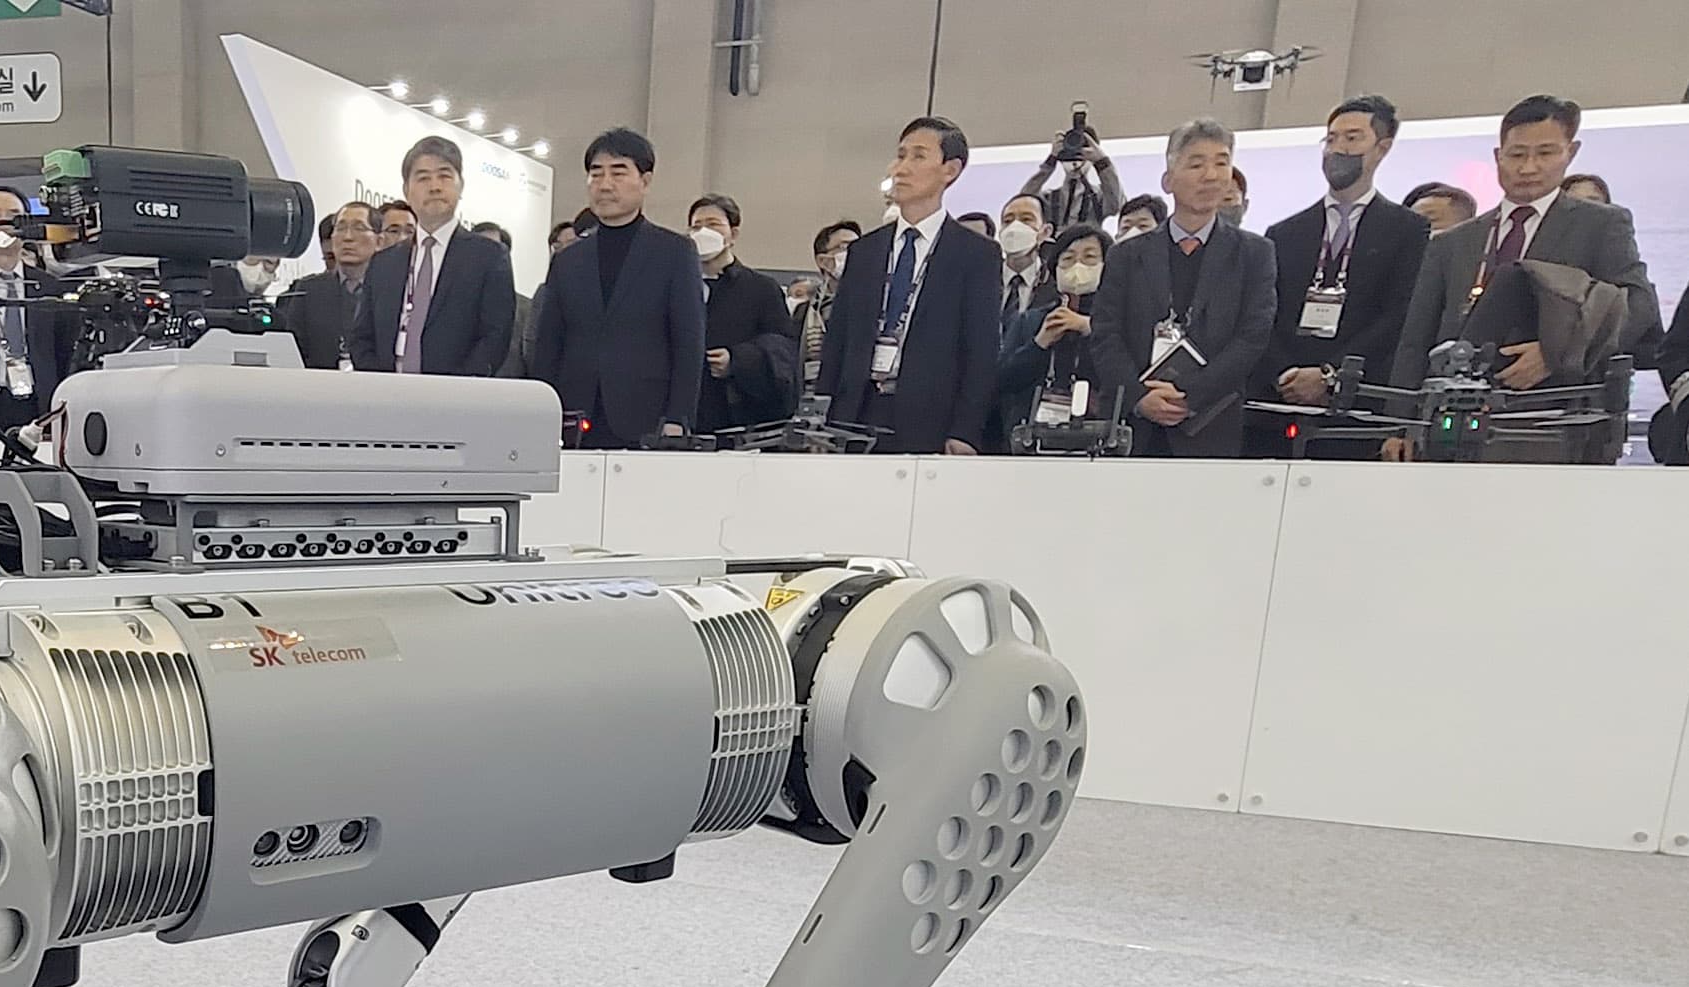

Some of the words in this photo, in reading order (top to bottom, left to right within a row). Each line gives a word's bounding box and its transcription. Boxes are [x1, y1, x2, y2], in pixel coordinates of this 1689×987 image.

[167, 594, 263, 619] B1
[249, 646, 286, 668] SK
[292, 646, 367, 665] telecom
